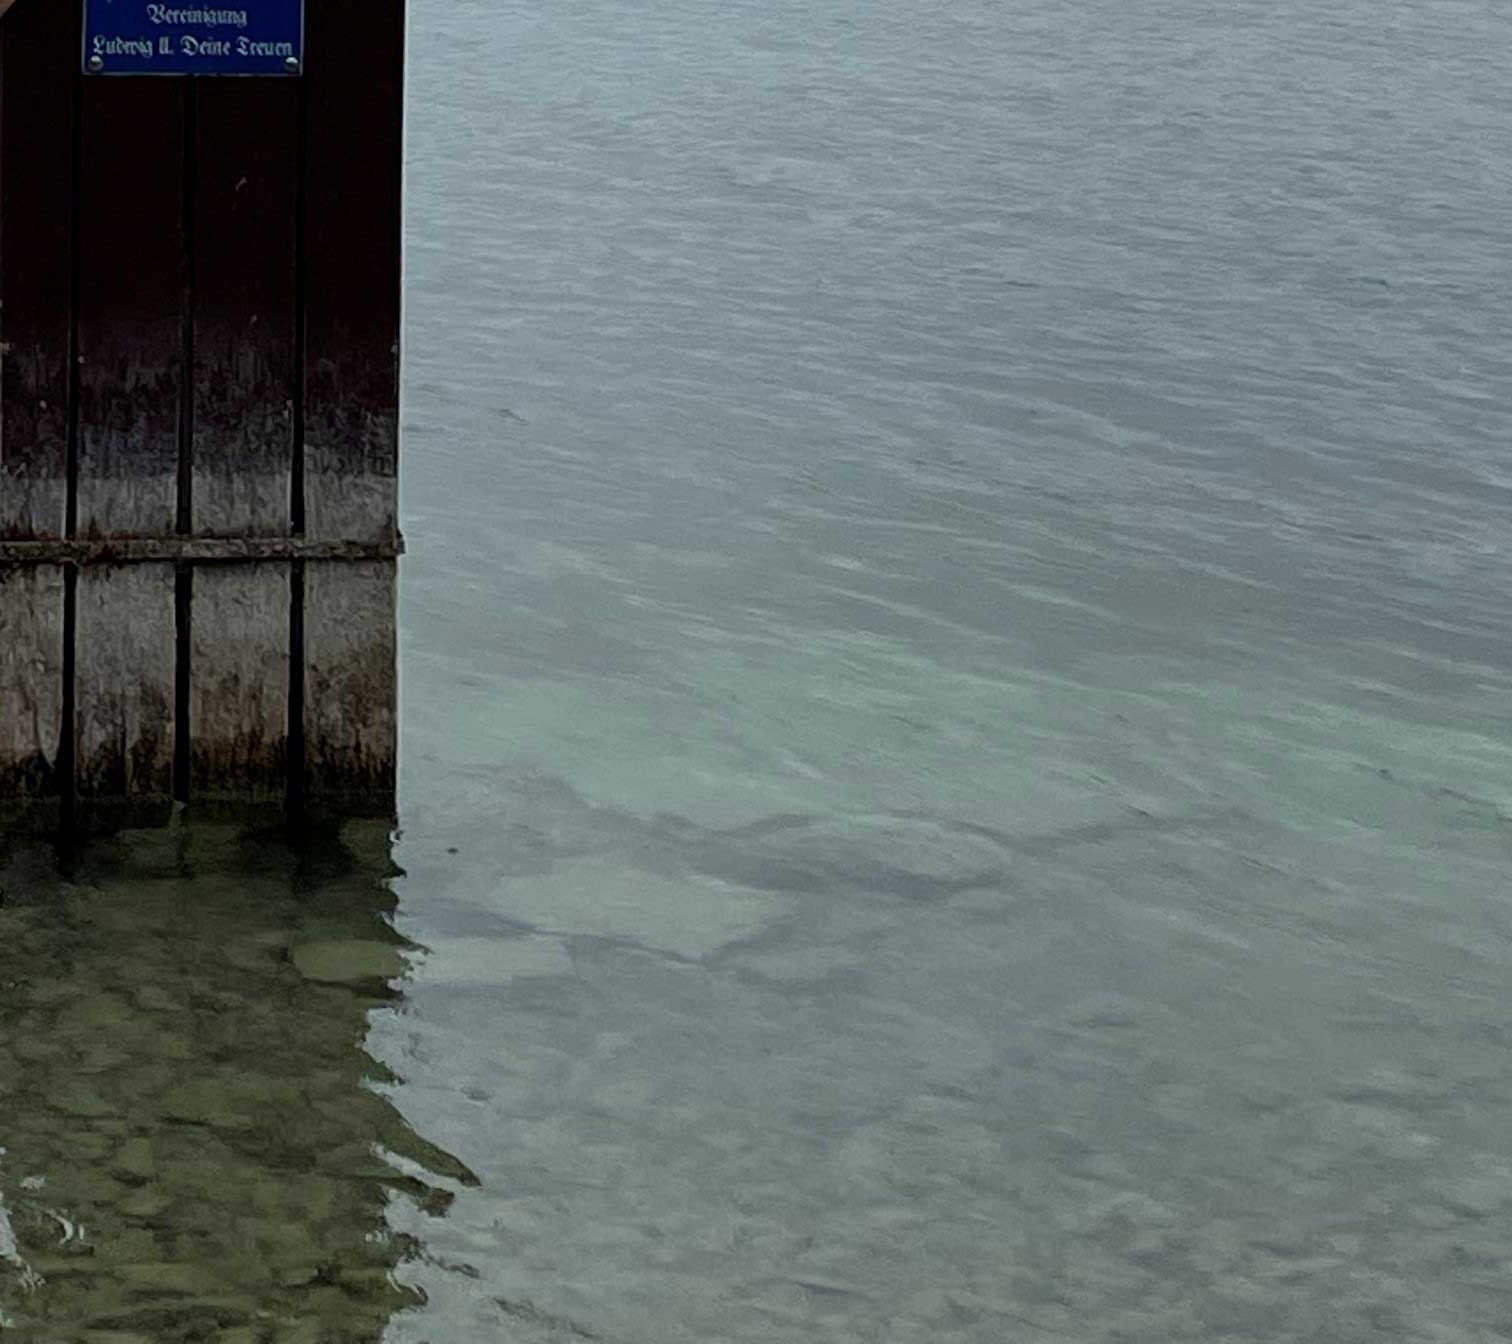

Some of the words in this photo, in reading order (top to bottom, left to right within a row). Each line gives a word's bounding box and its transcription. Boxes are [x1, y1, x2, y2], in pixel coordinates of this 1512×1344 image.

[146, 4, 248, 27] Vereinigung
[92, 34, 153, 58] Ludwig
[180, 35, 231, 56] Deine
[237, 35, 293, 56] Treuen
